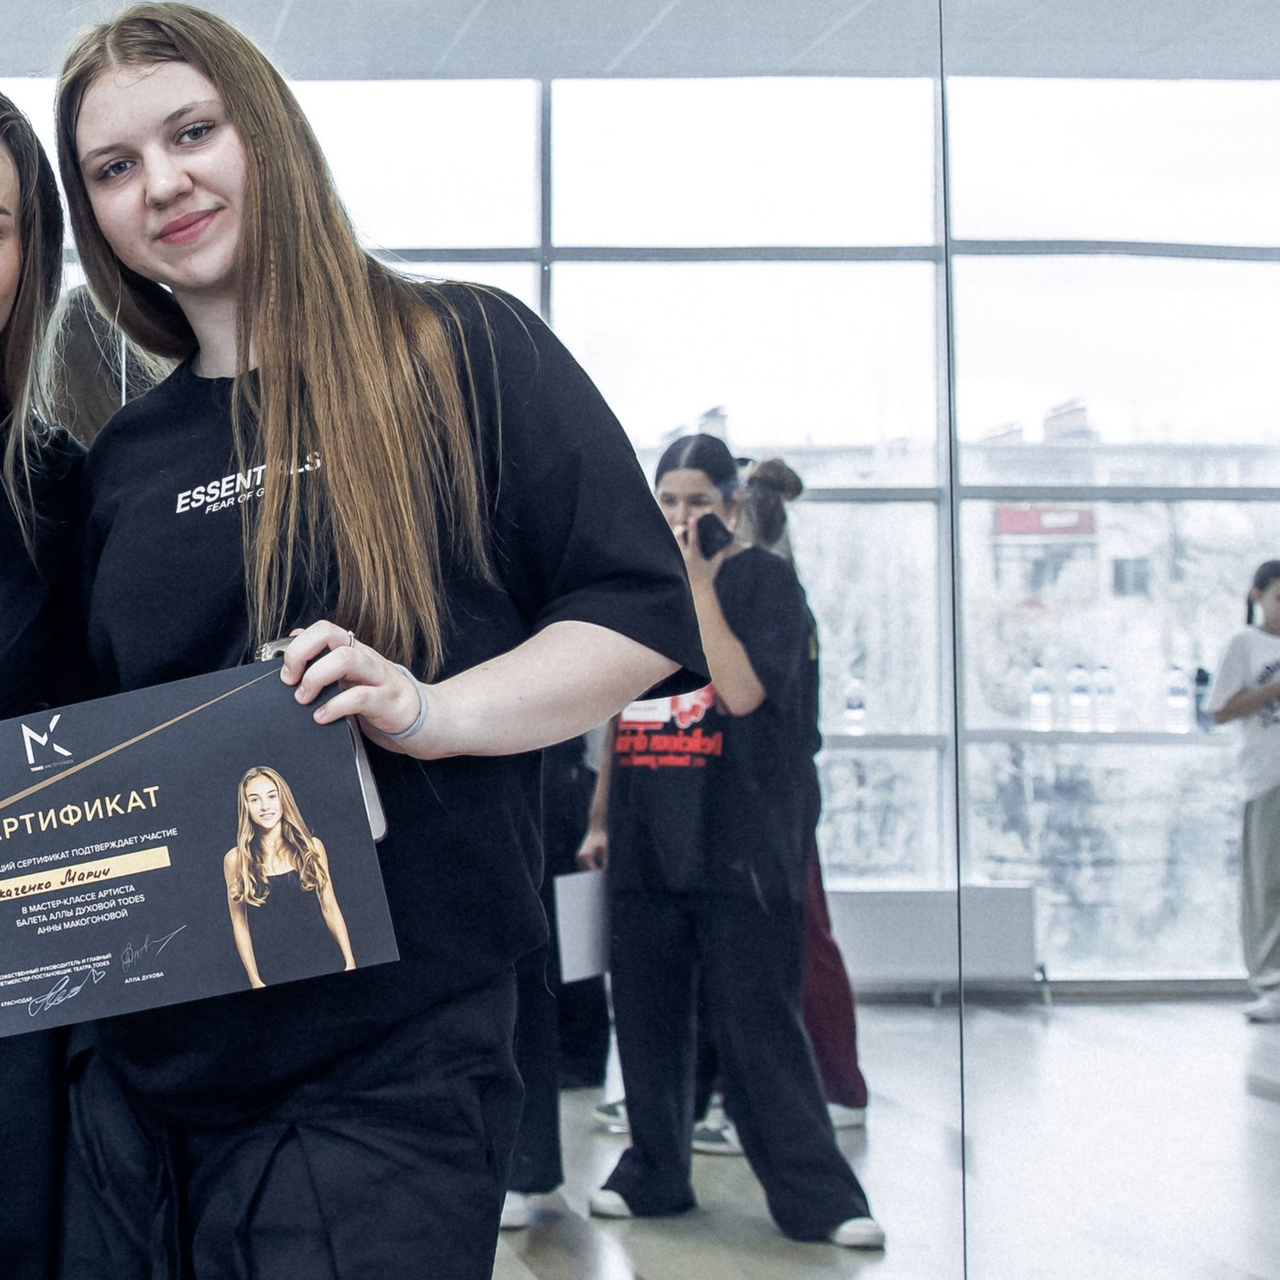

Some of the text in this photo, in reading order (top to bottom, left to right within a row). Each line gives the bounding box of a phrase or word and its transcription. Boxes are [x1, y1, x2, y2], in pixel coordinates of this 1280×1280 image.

[205, 496, 235, 514] FEAR
[237, 492, 253, 504] OF
[16, 850, 70, 869] СЕРТИФИКАТ
[71, 835, 138, 857] ПОДТВЕРЖДАЕТ
[139, 827, 178, 843] УЧАСТИЕ
[15, 893, 146, 928] БАЛЕТА АЛЛЫ ДУХОВОЙ TODES
[21, 884, 136, 915] В МАСТЕР-КЛАССЕ АРТИСТА
[37, 908, 129, 935] АННЫ МАКОГОНОВОЙ
[124, 976, 141, 984] АЛЛА
